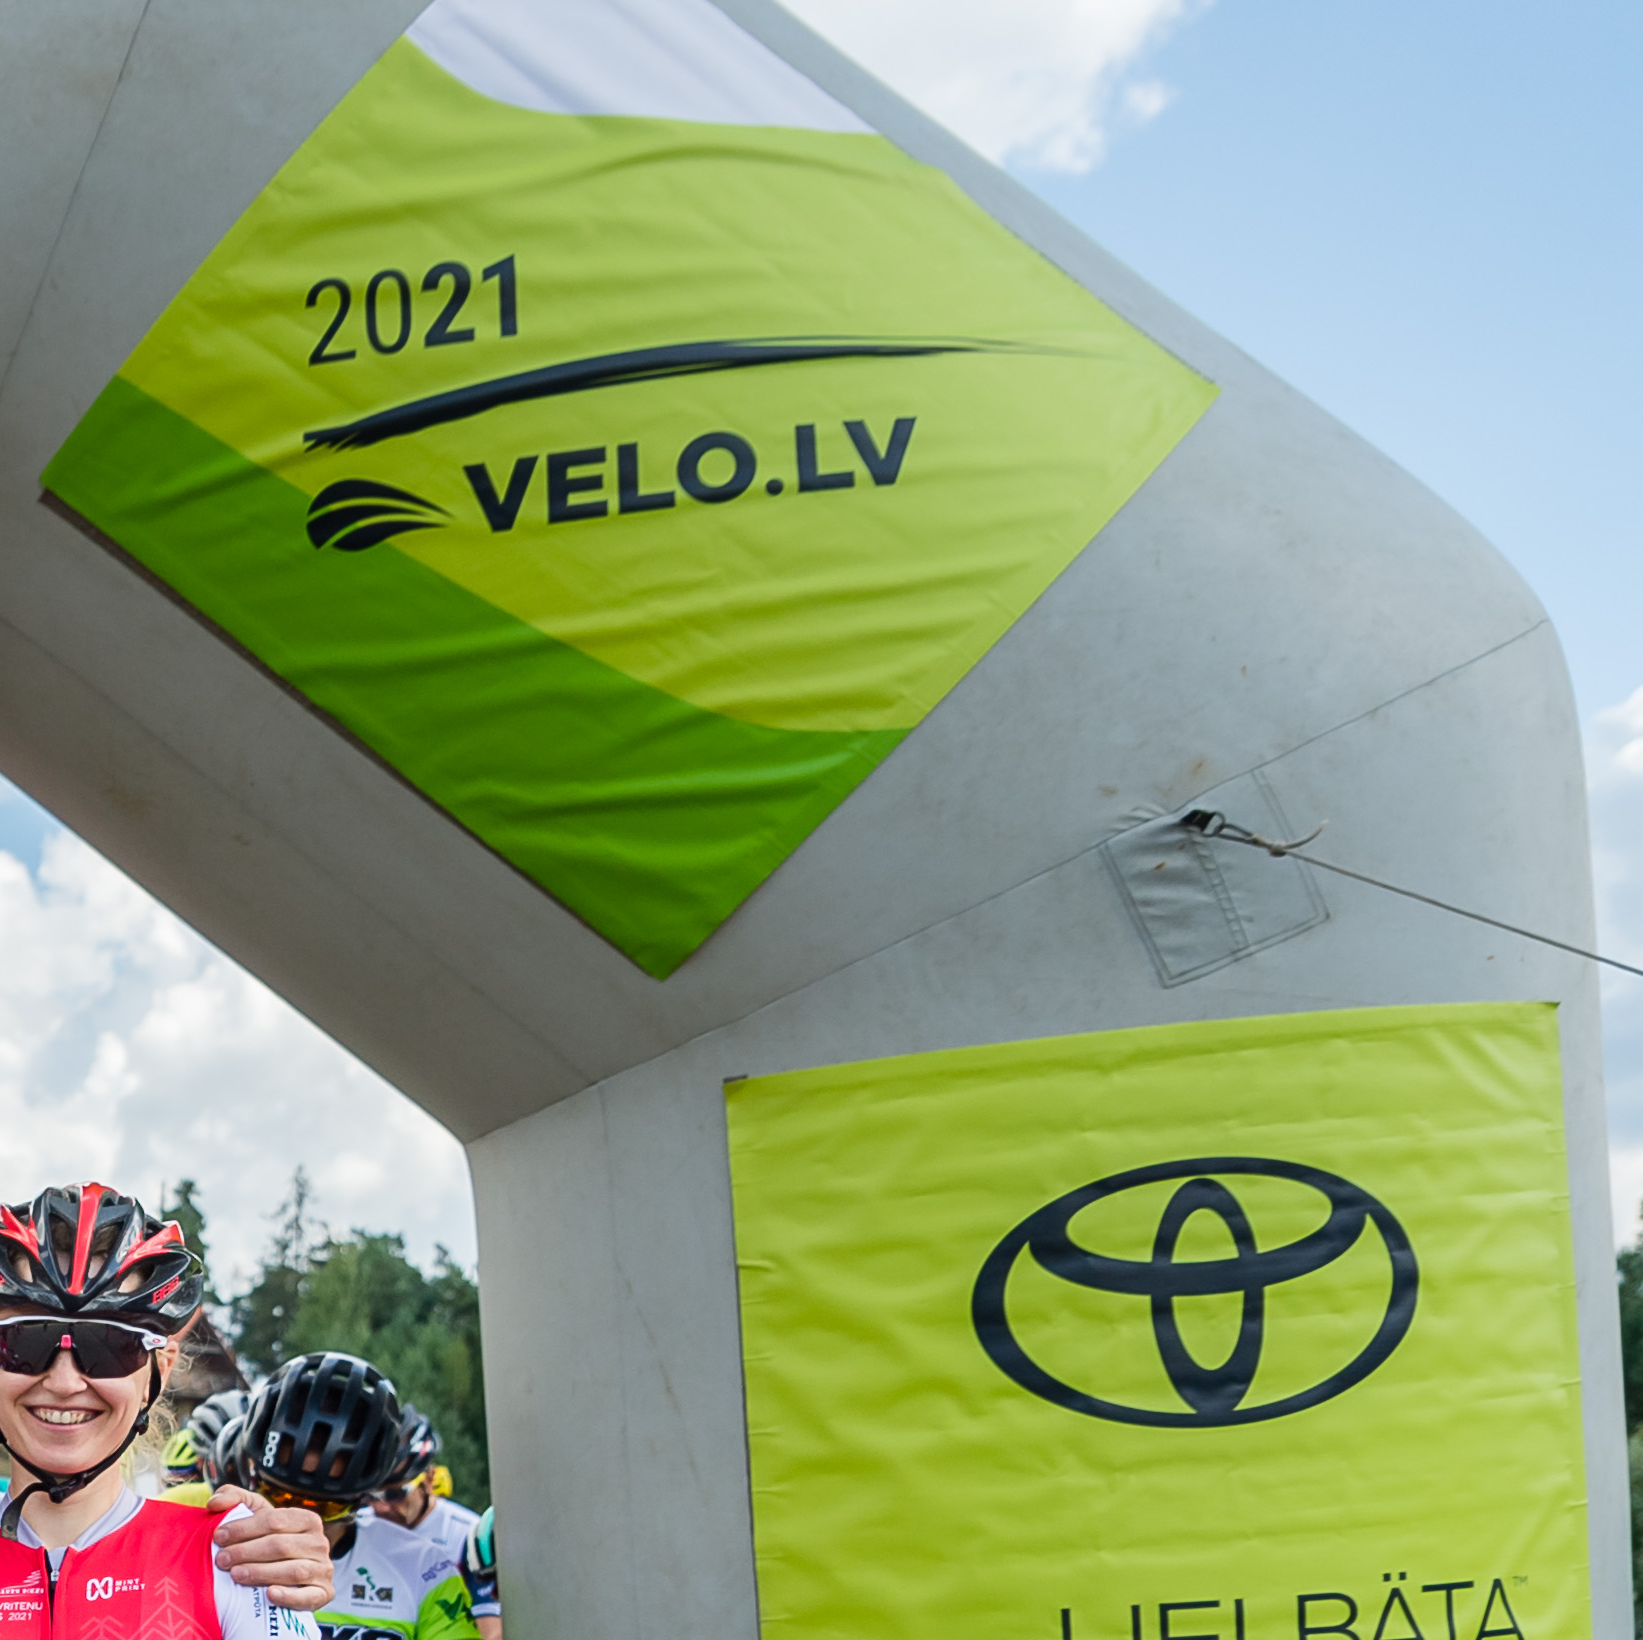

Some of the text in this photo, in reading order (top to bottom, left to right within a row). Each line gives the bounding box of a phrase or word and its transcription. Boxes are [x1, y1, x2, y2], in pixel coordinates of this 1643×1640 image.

[305, 254, 519, 366] 2021
[463, 416, 918, 534] VELO.LV
[262, 1430, 281, 1468] POC
[114, 1583, 147, 1593] PRINT
[115, 1578, 141, 1587] MINT
[7, 1611, 33, 1622] 2021
